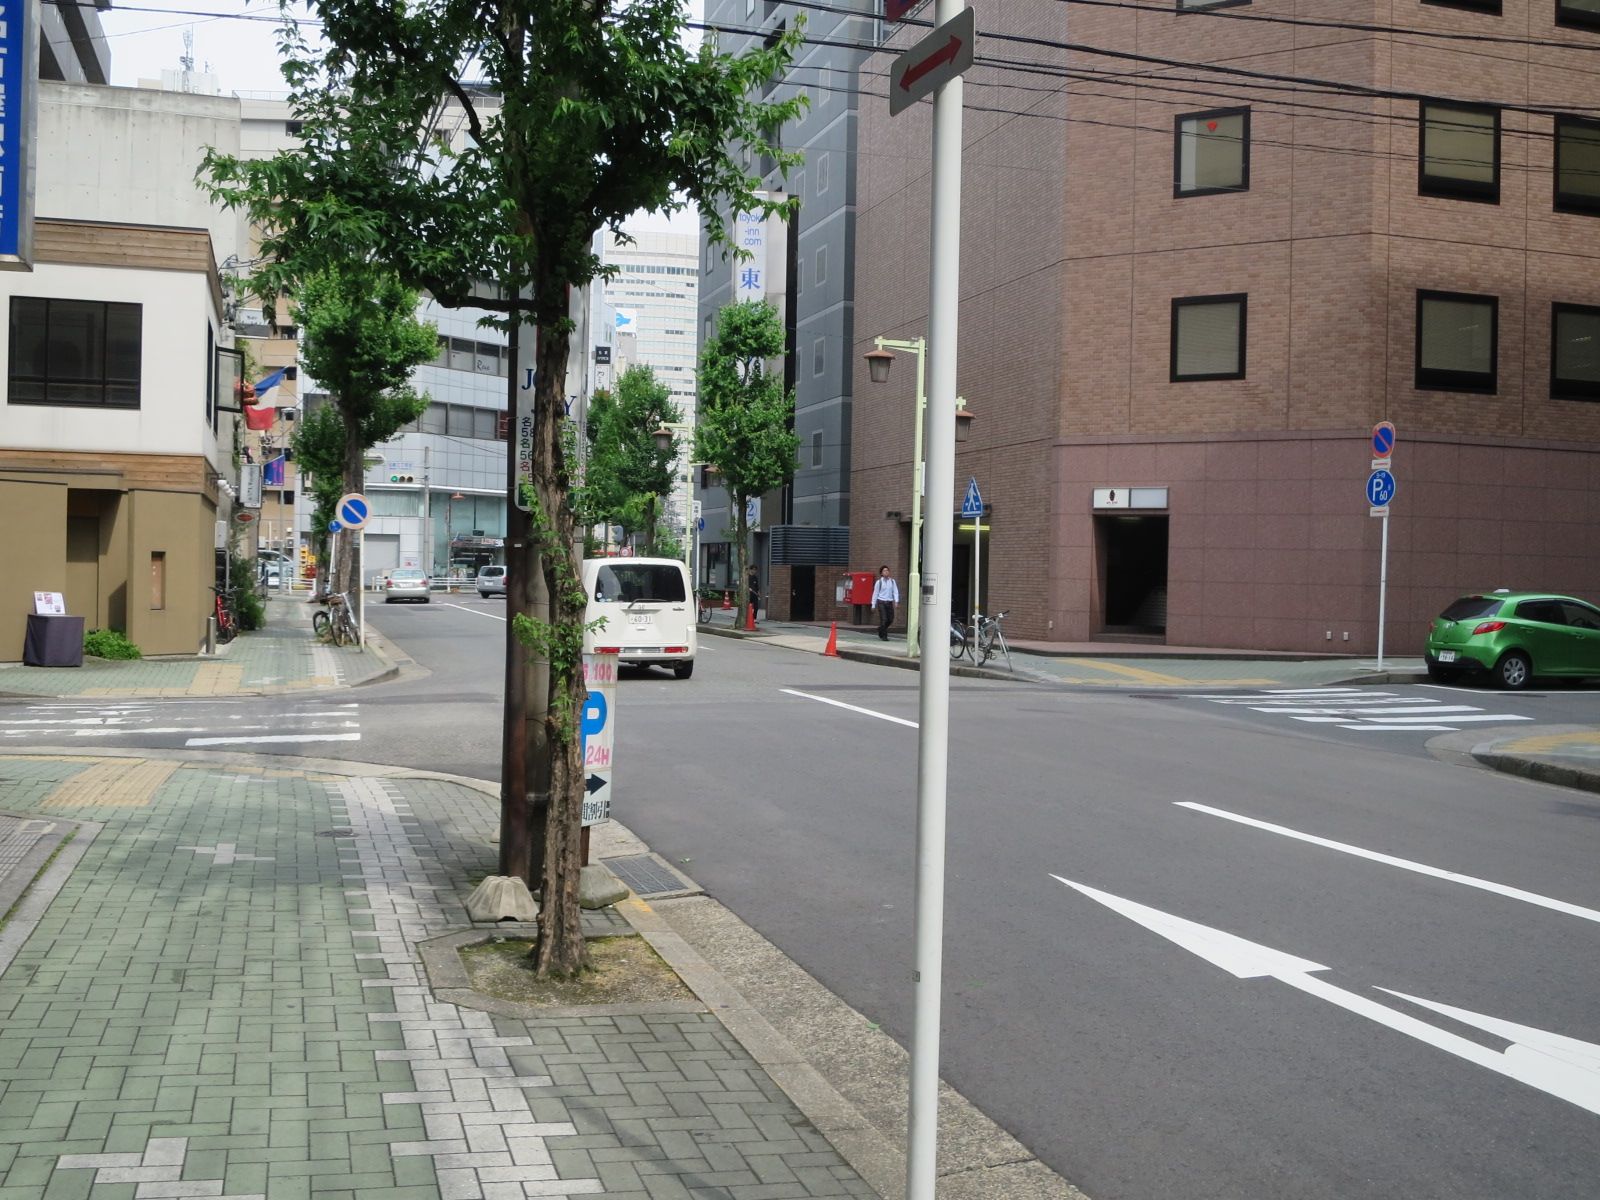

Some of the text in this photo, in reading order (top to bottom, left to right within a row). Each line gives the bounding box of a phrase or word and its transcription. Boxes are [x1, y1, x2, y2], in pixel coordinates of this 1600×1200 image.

[739, 212, 766, 224] toyok
[745, 228, 760, 236] -inn
[740, 268, 761, 290] 東
[1372, 479, 1384, 501] P
[1379, 490, 1388, 501] 60
[580, 691, 608, 765] P
[586, 745, 610, 765] 24H
